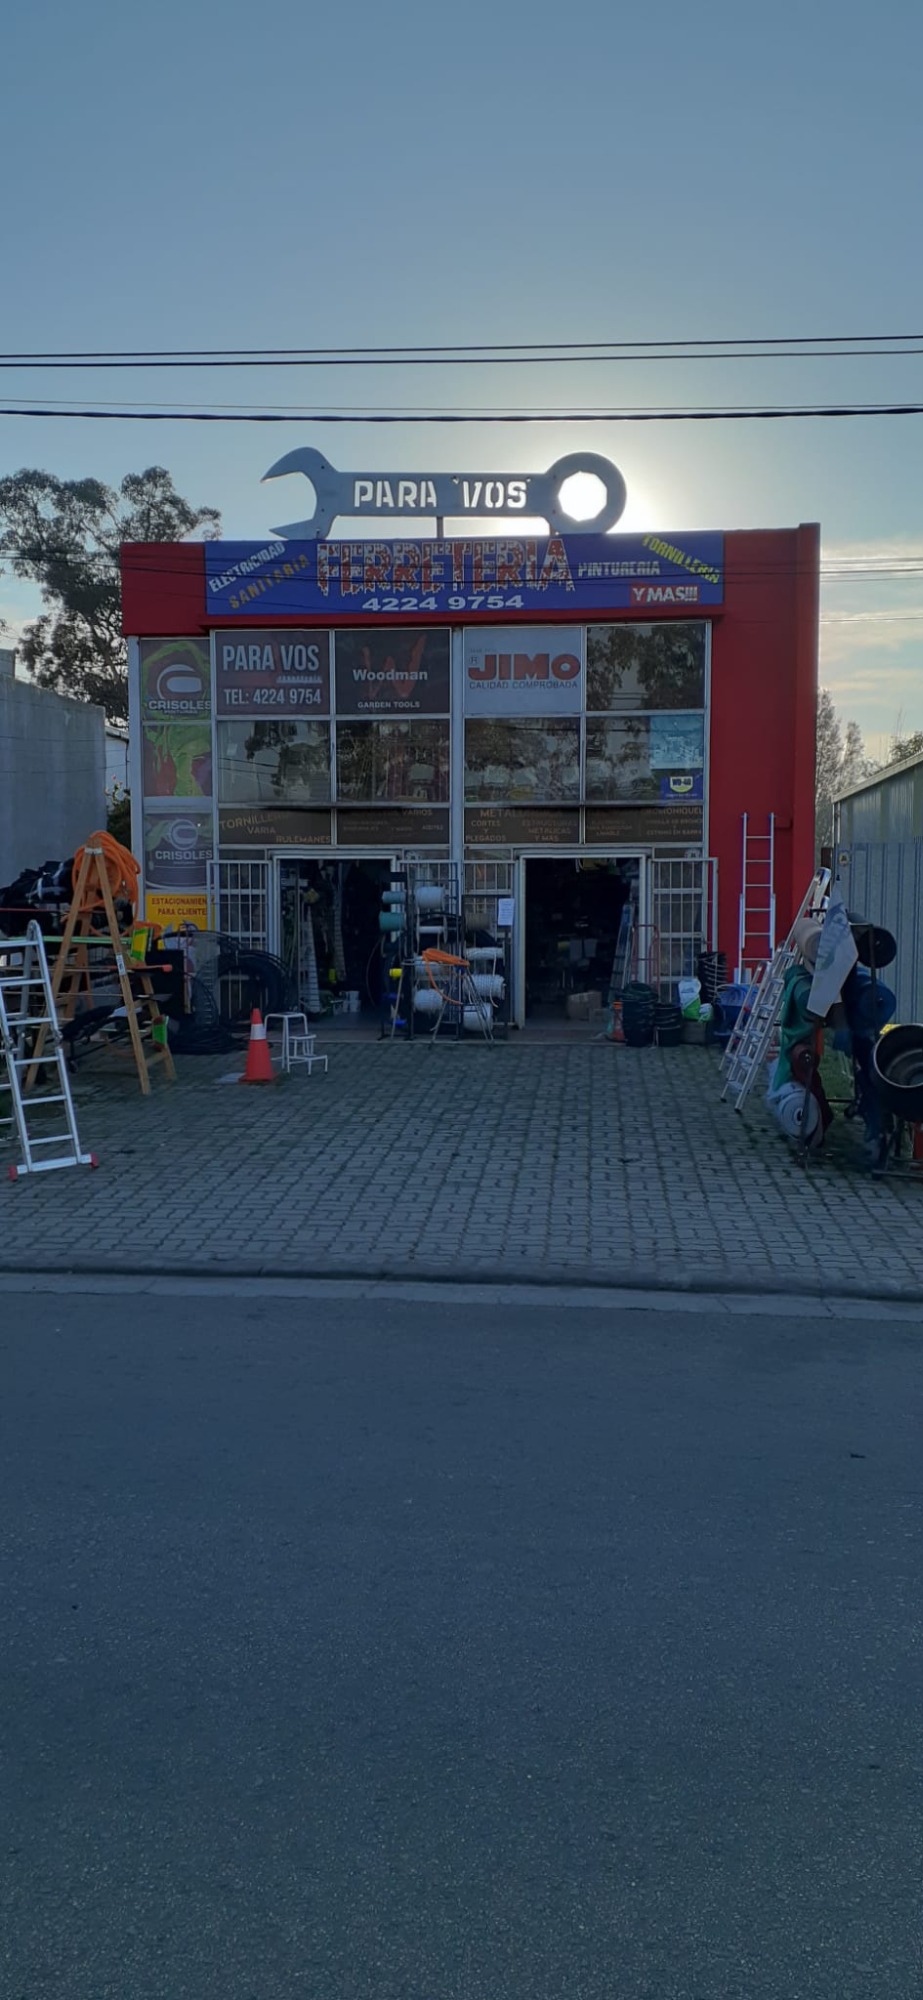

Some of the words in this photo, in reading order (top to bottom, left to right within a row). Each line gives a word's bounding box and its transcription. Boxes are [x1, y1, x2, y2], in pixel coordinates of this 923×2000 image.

[354, 480, 437, 508] PARA
[462, 480, 527, 508] VOS
[208, 541, 287, 593] ELECTRICIDAD
[316, 538, 576, 597] FERRETERIA
[642, 534, 720, 585] TORNILLERIA
[578, 560, 661, 577] PINTURERIA
[229, 553, 311, 610] SANITARIA
[632, 587, 645, 602] Y
[361, 597, 438, 612] 4224
[448, 595, 525, 610] 9754
[222, 645, 275, 671] PARA
[280, 645, 320, 671] VOS
[468, 653, 581, 680] JIMO
[352, 668, 429, 681] Woodman
[469, 681, 509, 690] CALIDAD
[512, 680, 579, 690] COMPROBADA
[149, 699, 211, 710] CRISOLES
[224, 688, 250, 705] TEL:
[253, 688, 285, 705] 4224
[289, 688, 322, 705] 9754
[357, 701, 392, 709] GARDEN
[394, 701, 421, 709] TOOLS
[155, 850, 213, 861] CRISOLES
[151, 897, 214, 905] ESTACIONAMIEN
[177, 907, 207, 915] CLIENTE
